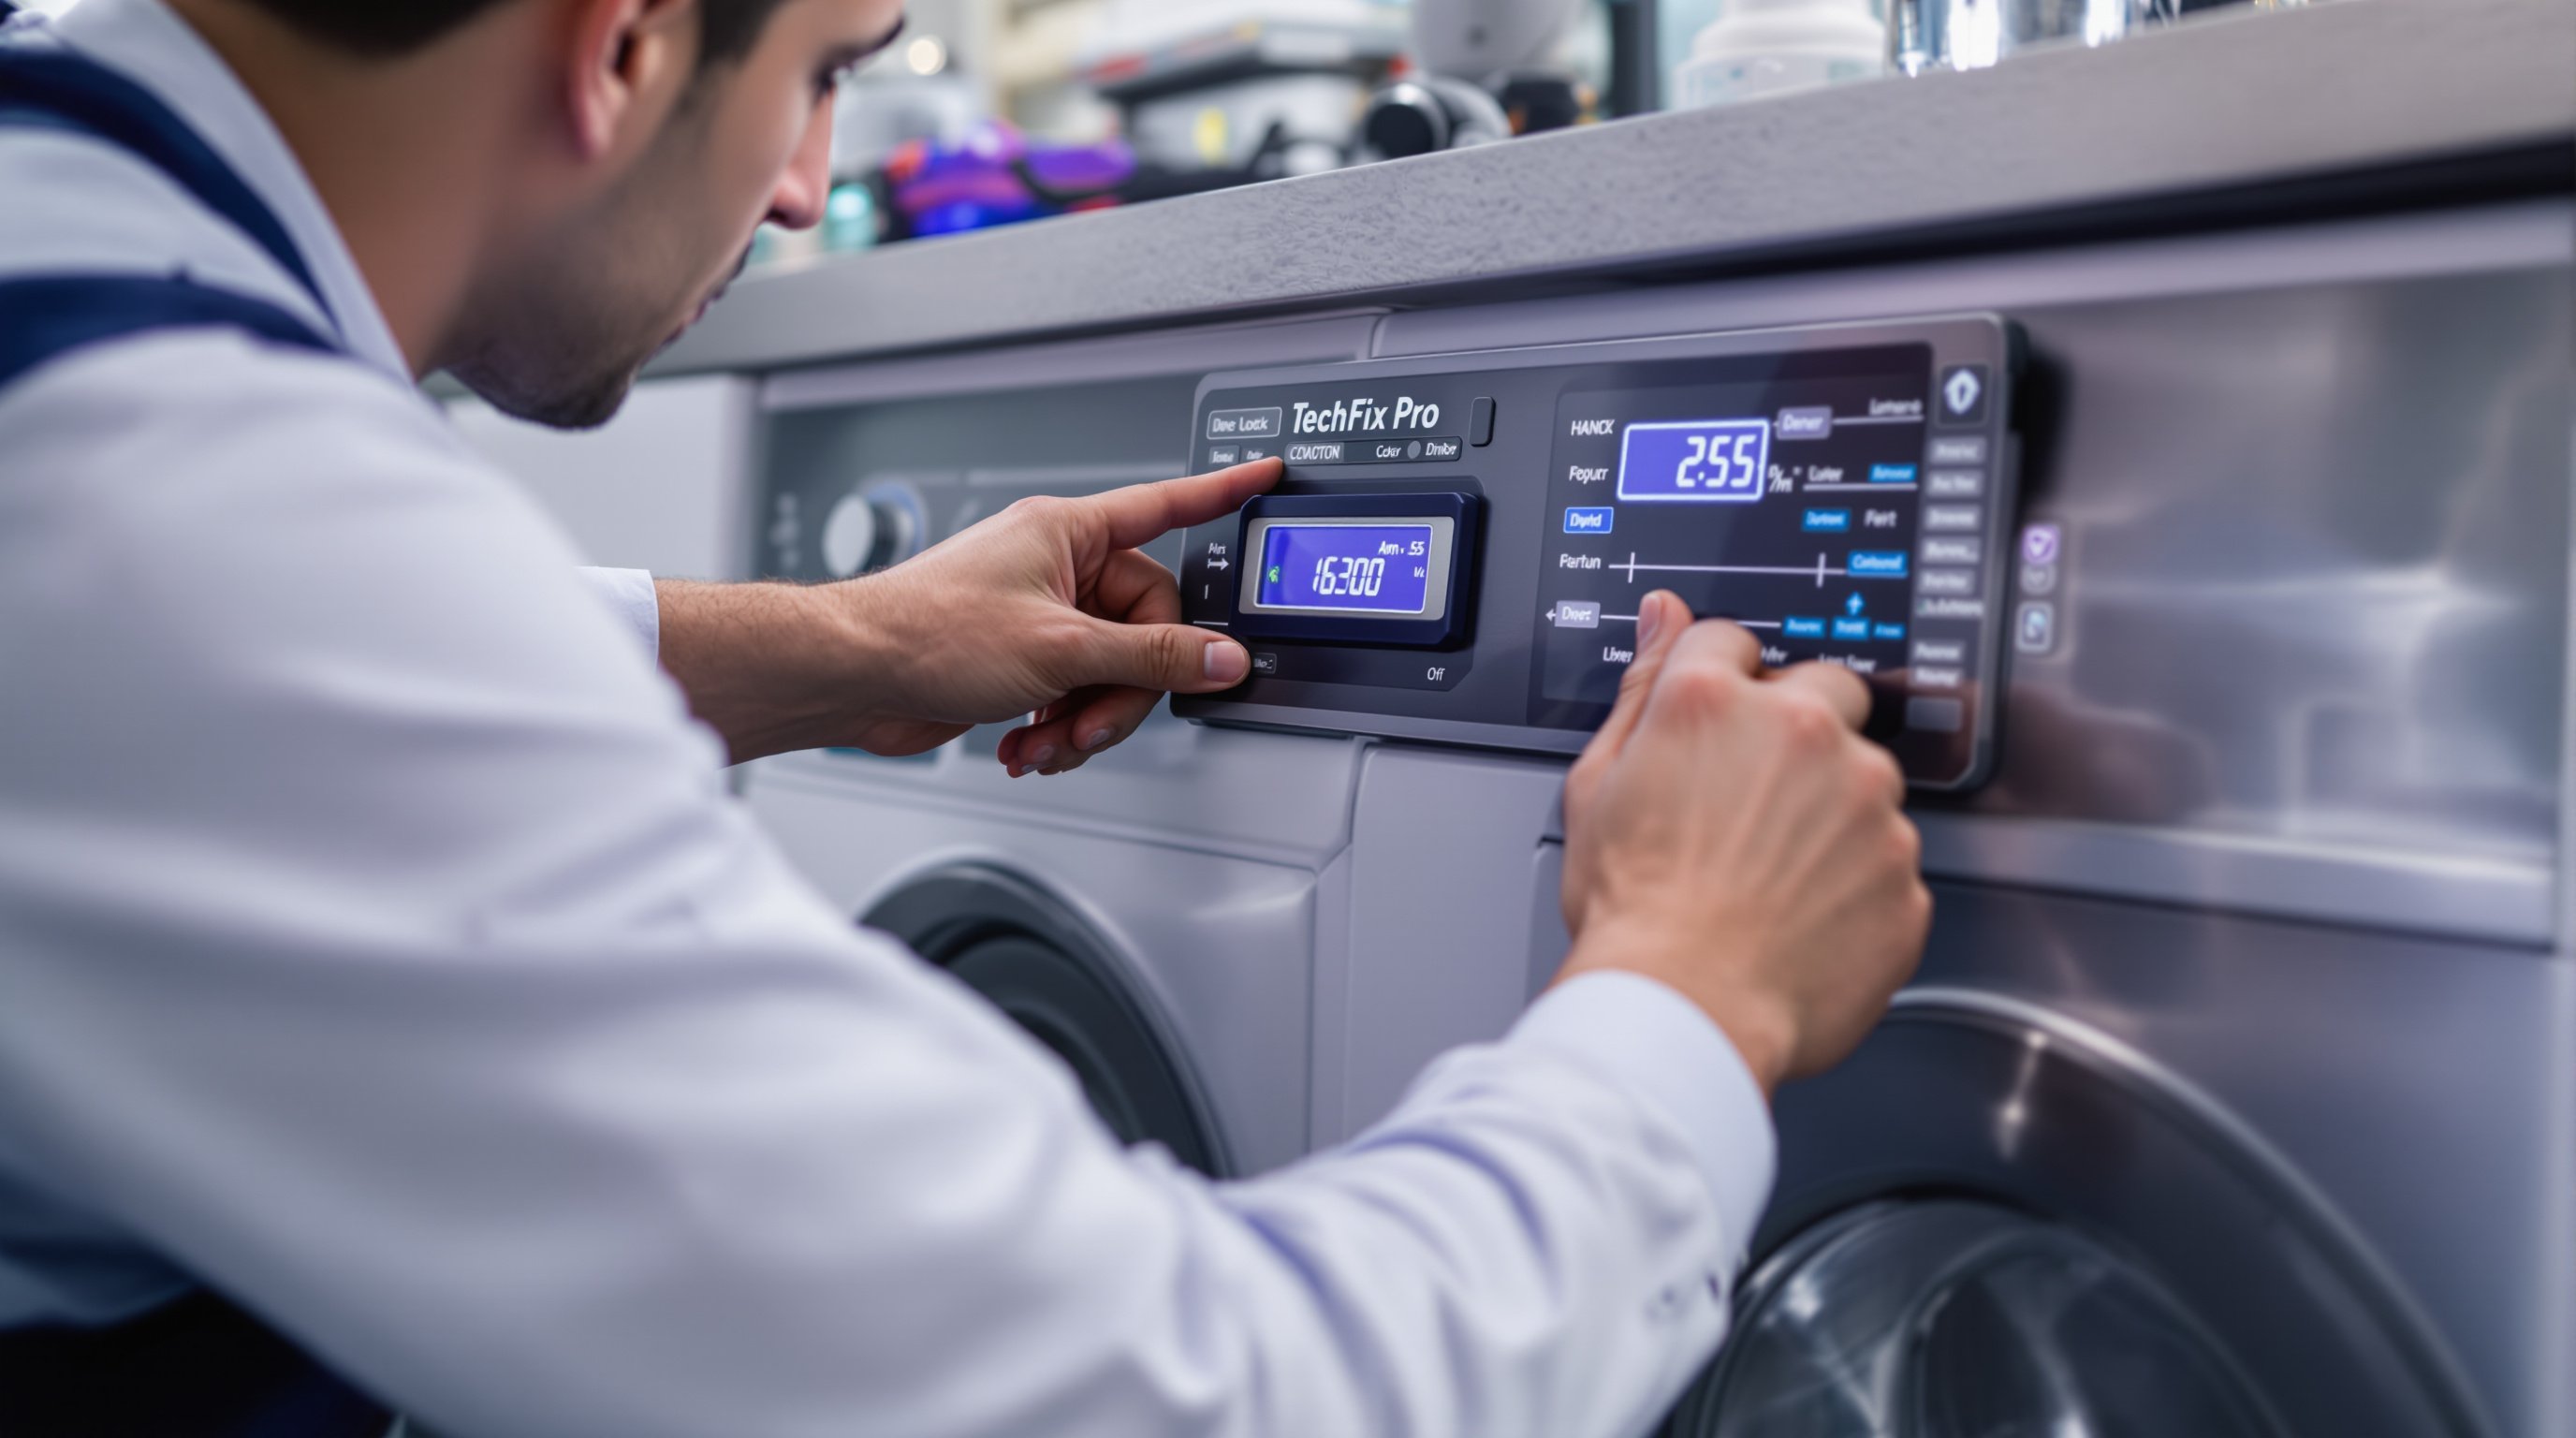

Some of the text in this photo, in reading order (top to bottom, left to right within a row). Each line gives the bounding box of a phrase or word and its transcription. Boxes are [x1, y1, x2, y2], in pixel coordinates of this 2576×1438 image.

[1293, 396, 1440, 433] TechFix Pro
[1676, 434, 1758, 488] 2.55
[1312, 556, 1385, 596] 16300
[1427, 667, 1445, 682] Off
